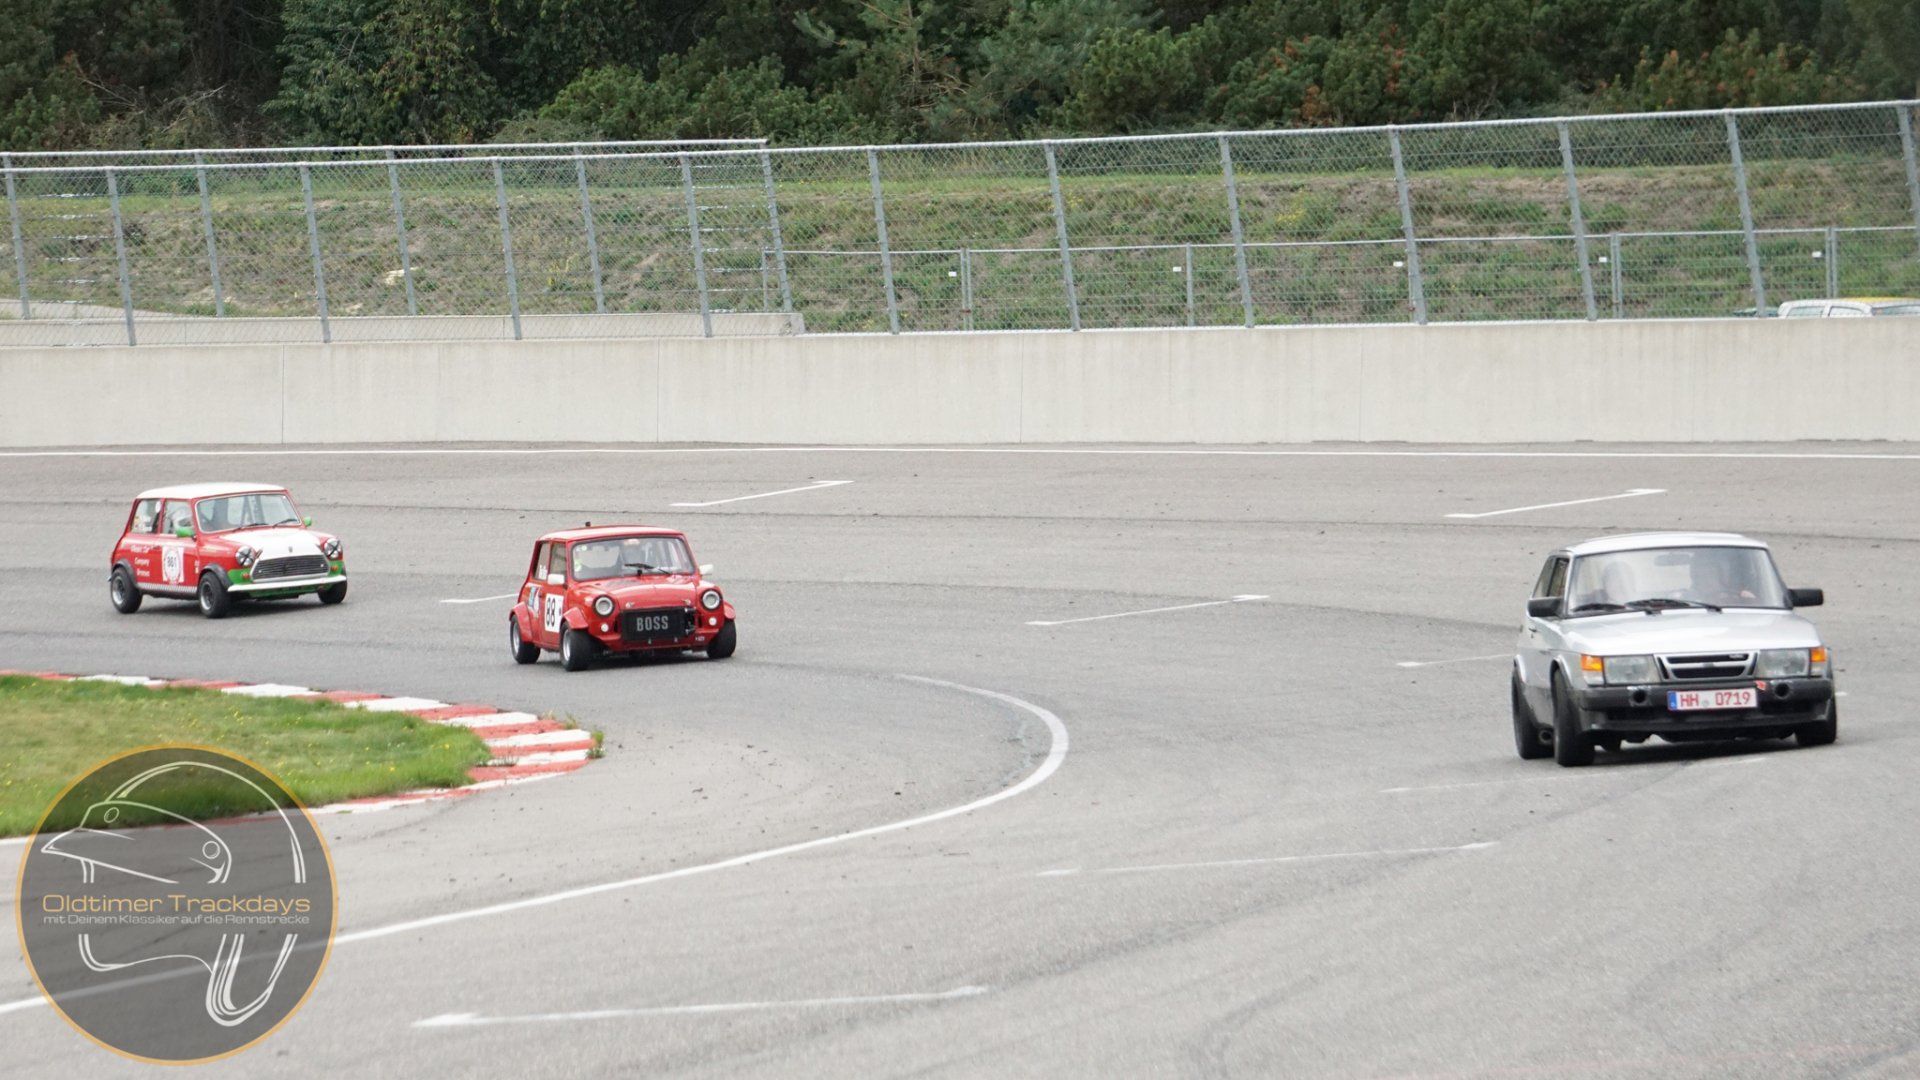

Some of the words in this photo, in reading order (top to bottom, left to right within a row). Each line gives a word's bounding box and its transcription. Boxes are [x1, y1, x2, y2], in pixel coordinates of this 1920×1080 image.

[546, 597, 556, 627] 88
[637, 616, 668, 631] BOSS
[1680, 693, 1699, 707] HH
[1715, 691, 1751, 705] 0719
